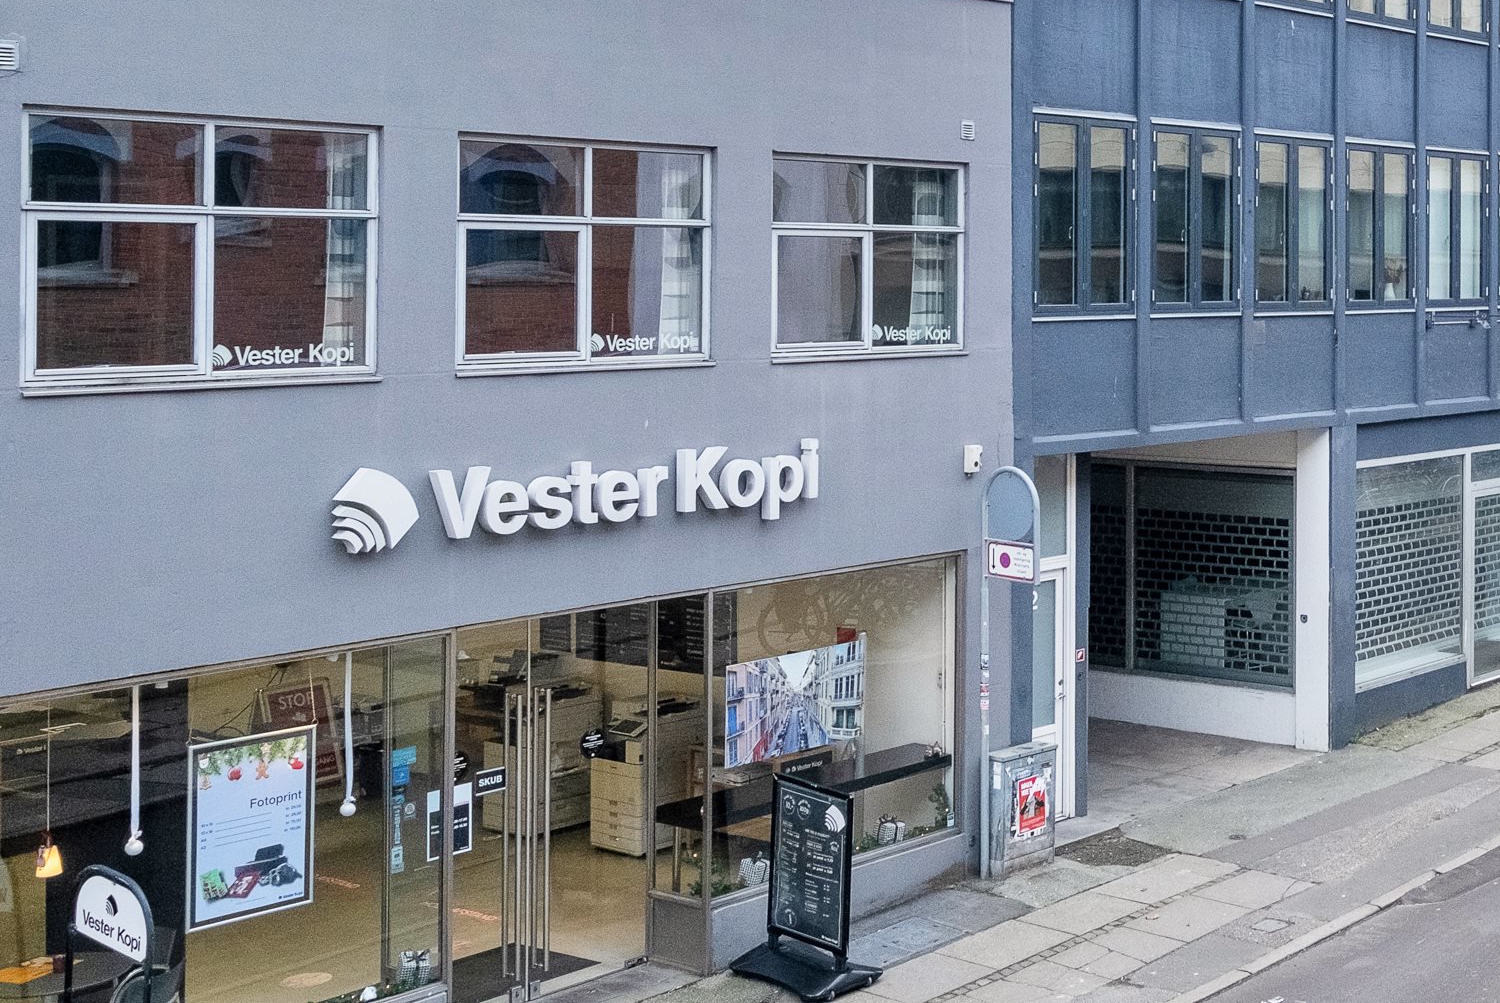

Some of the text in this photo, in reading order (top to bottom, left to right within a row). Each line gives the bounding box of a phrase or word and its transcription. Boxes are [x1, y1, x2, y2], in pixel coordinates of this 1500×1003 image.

[606, 331, 695, 352] Vester Kopi
[884, 325, 951, 345] Vester Kopi
[234, 342, 354, 367] Vester Kopi
[429, 438, 819, 539] Vester Kopi
[478, 774, 503, 787] SKUB
[250, 790, 302, 809] Fotoprint
[82, 908, 141, 953] Vester Kopi
